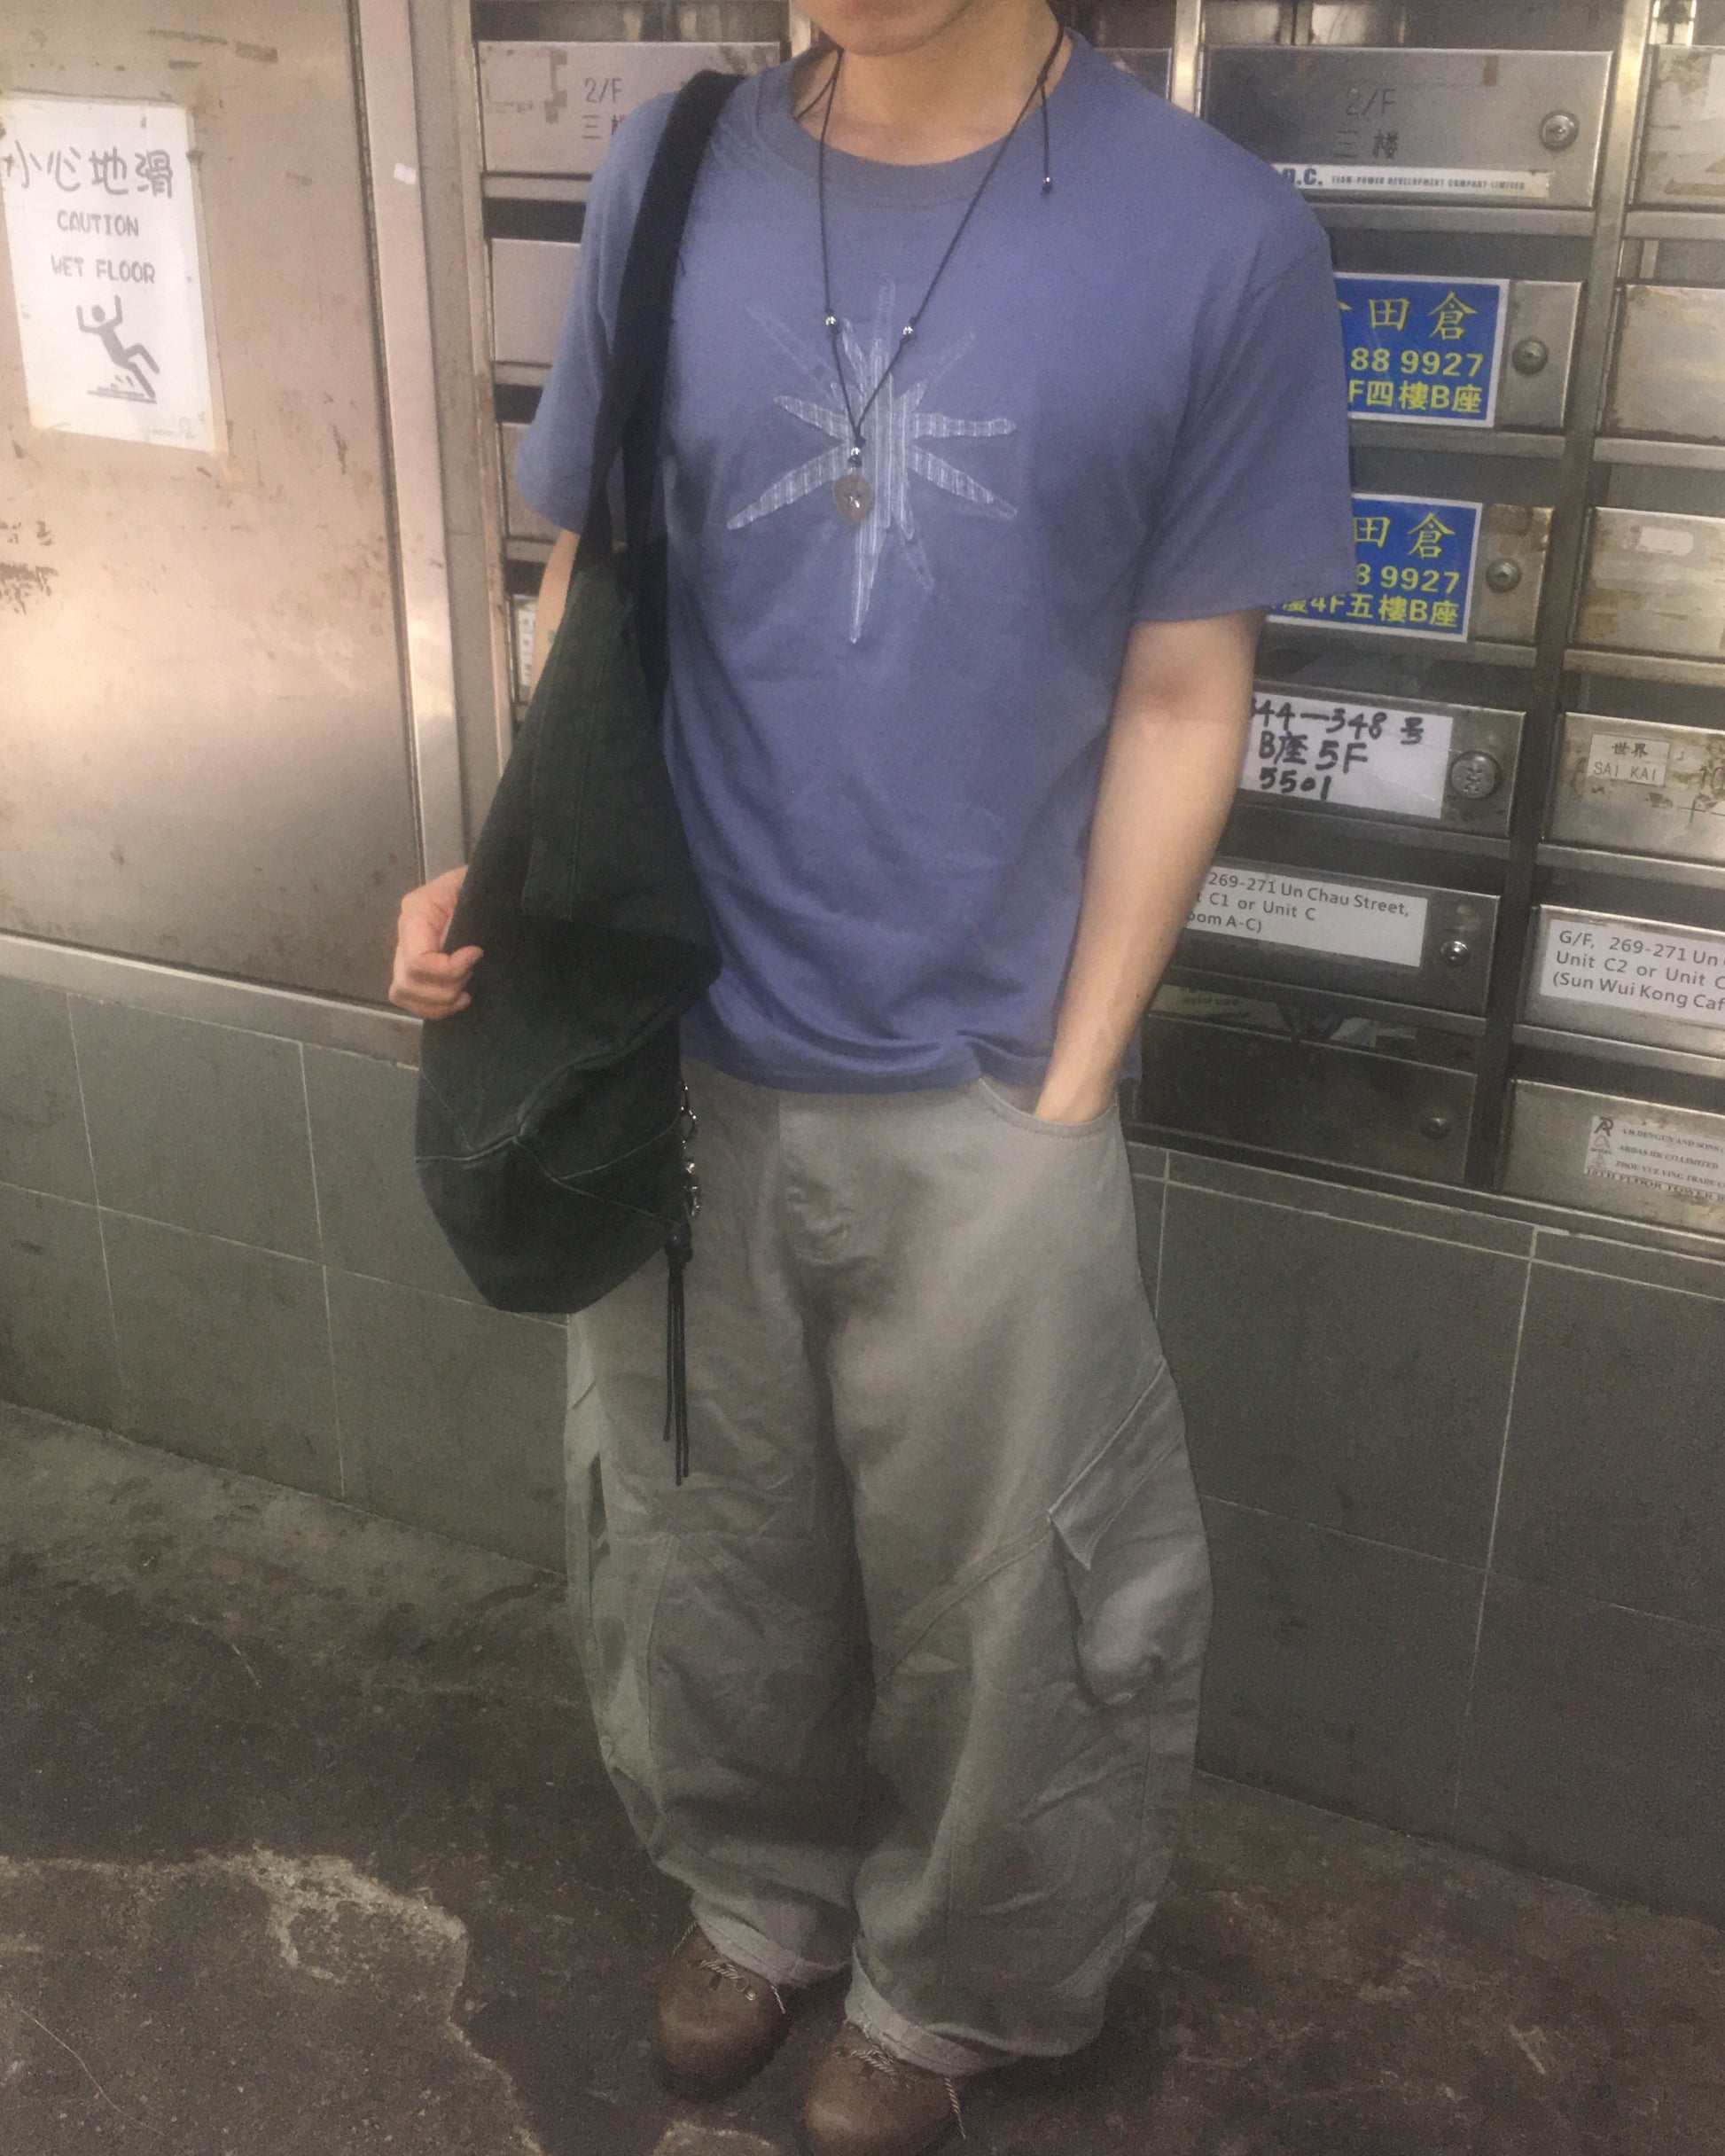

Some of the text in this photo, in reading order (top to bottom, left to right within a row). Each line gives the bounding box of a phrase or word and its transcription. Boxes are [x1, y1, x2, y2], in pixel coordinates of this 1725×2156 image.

[584, 77, 622, 104] 2/F
[1346, 88, 1397, 116] 2/F
[5, 140, 174, 199] 小心地滑
[1387, 176, 1445, 187] DEVELOPMENT
[1491, 180, 1526, 190] LIMITED
[57, 209, 140, 238] CAUTION
[51, 253, 156, 284] WET FLOOR
[1337, 291, 1478, 340] 田倉
[1350, 348, 1484, 377] 88 9927
[1380, 566, 1460, 594] 9927
[1315, 739, 1368, 775] 5F
[1611, 741, 1649, 759] 世界
[1593, 761, 1657, 783] SAI KAI
[1208, 871, 1409, 918] 269-271 Un Chau Street,
[1209, 893, 1229, 907] C1
[1237, 898, 1255, 911] or
[1262, 900, 1297, 918] Unit
[1305, 908, 1316, 921] C
[1226, 916, 1262, 933] A-C)
[1558, 930, 1718, 967] G/F, 269-271 Un
[1556, 950, 1596, 969] Unit
[1604, 957, 1627, 973] C2
[1636, 965, 1657, 978] or
[1666, 967, 1705, 987] Unit
[1552, 971, 1594, 989] (Sun
[1599, 978, 1635, 996] Wui
[1640, 984, 1689, 1008] Kong
[1675, 1137, 1696, 1148] AND
